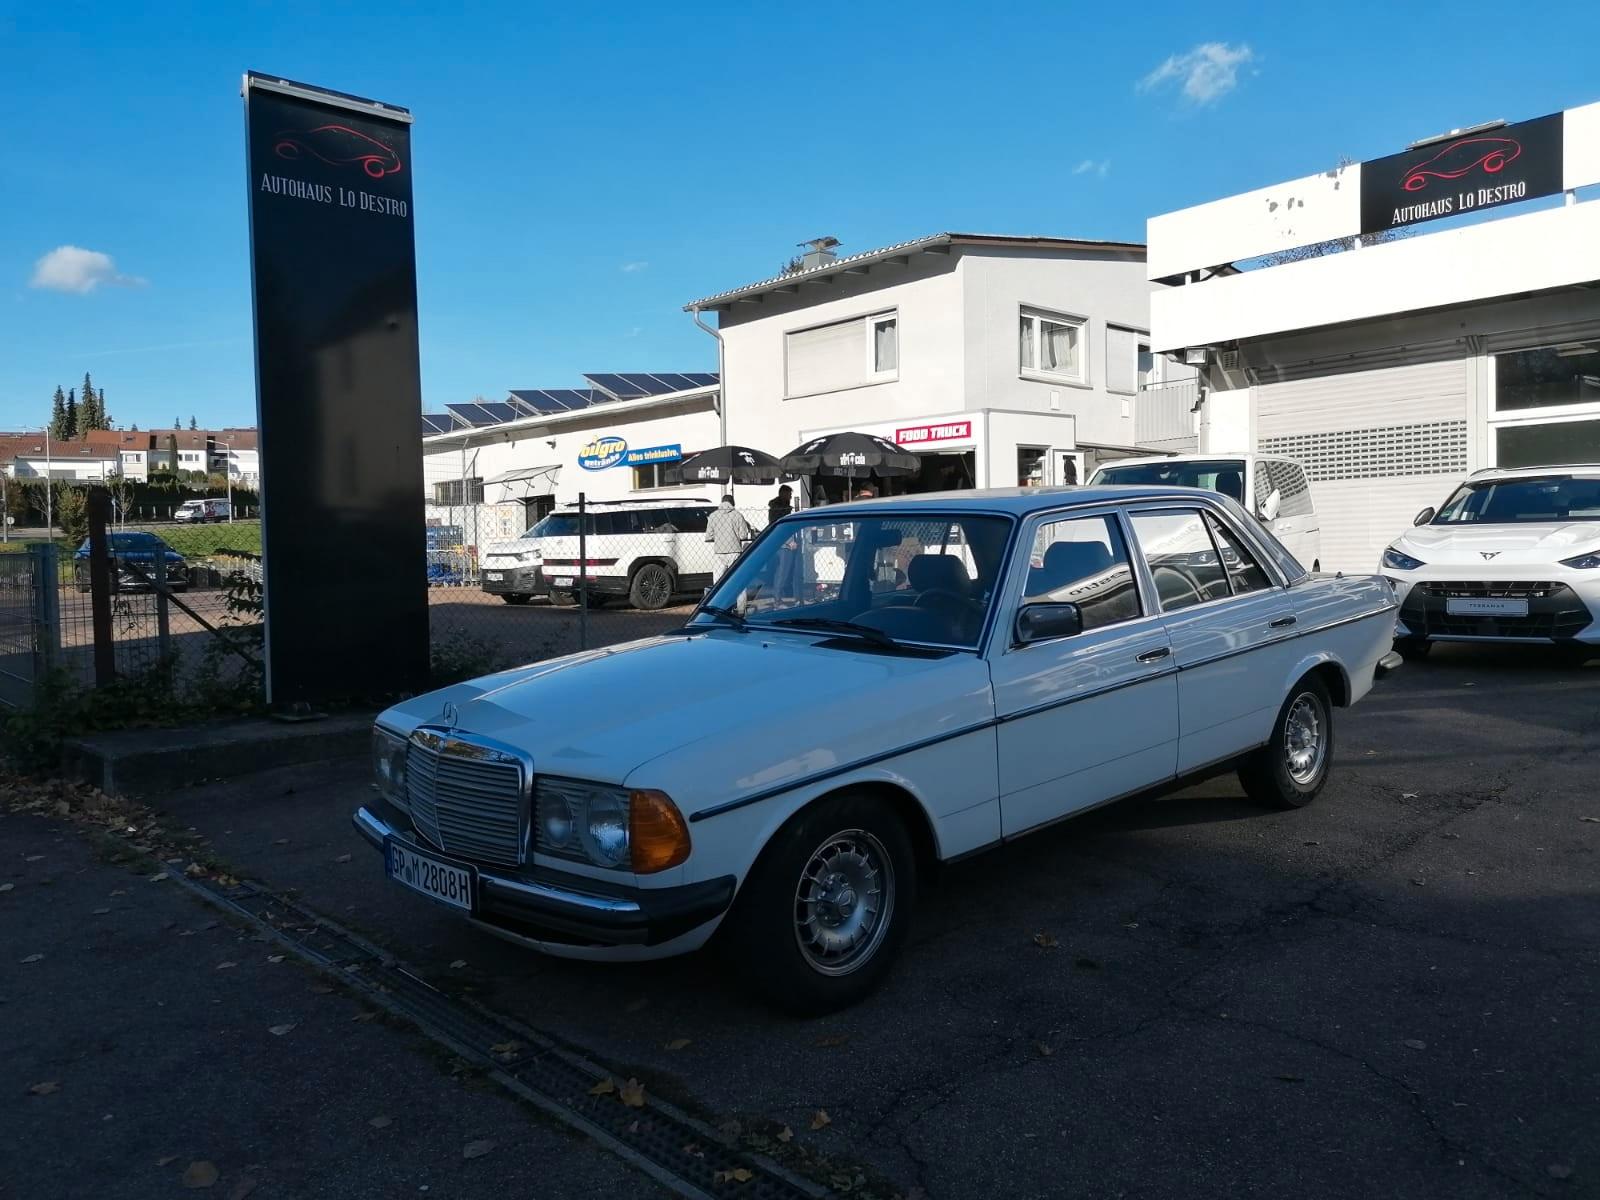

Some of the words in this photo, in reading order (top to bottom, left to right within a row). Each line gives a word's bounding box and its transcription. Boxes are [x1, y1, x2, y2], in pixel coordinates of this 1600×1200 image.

[260, 172, 332, 204] AUTOHAUS
[339, 187, 356, 208] LO
[360, 191, 408, 218] DESTRO
[1391, 197, 1453, 225] AUTOHAUS
[1458, 191, 1475, 210] LO
[1478, 181, 1526, 206] DESTRO
[898, 428, 929, 442] FOOD
[929, 424, 968, 439] TRUCK
